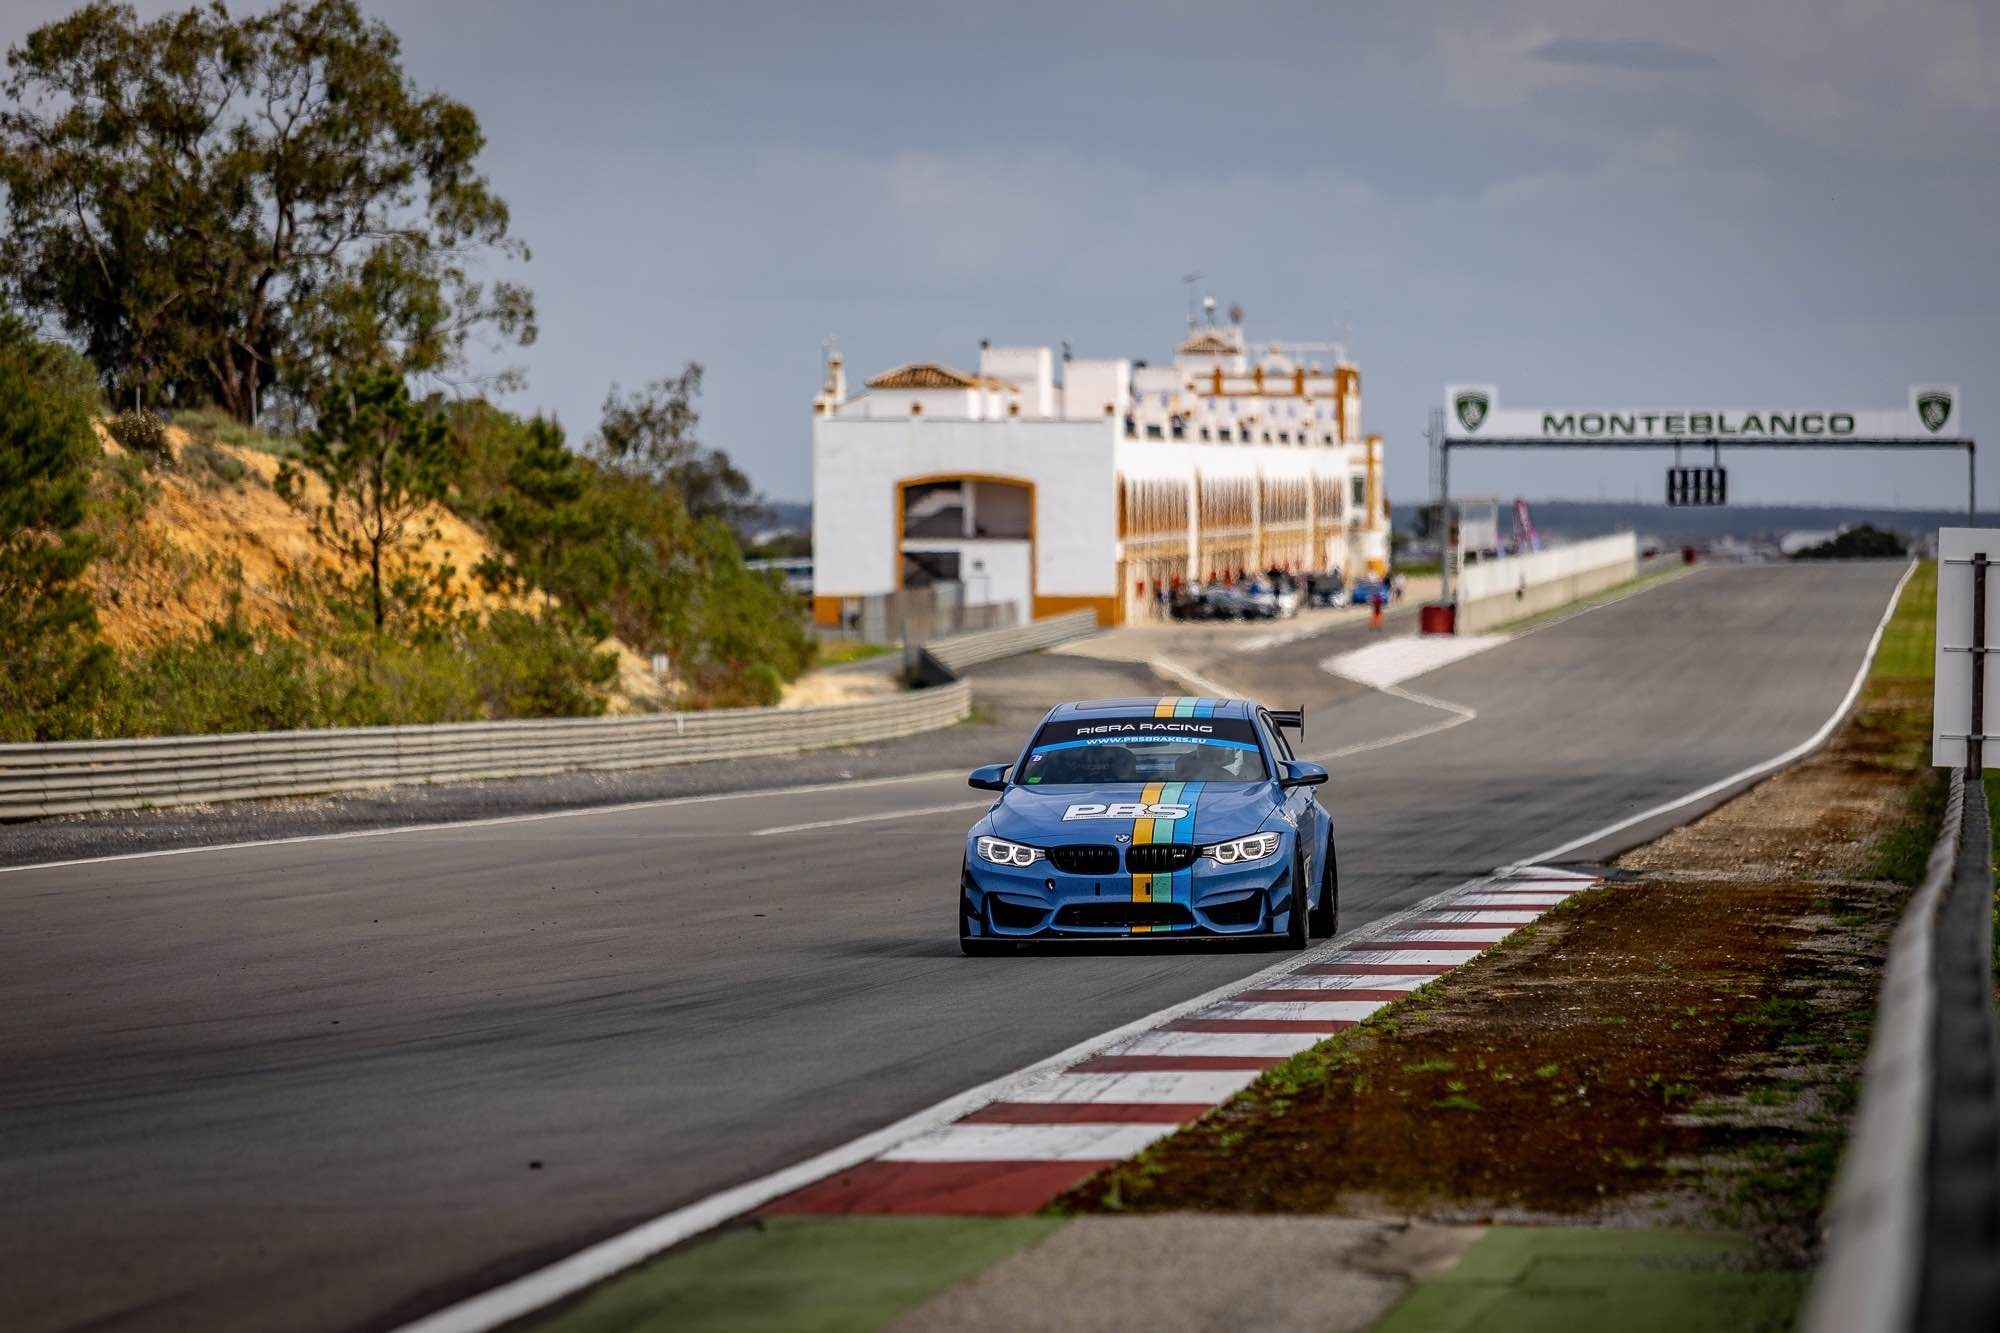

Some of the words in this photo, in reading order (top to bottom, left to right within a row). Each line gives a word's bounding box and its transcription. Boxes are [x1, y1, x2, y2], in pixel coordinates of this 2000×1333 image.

[1542, 413, 1855, 435] MONTEBLANCO
[1076, 724, 1135, 735] RIERA
[1140, 723, 1213, 733] RACING
[1062, 803, 1192, 821] PBS
